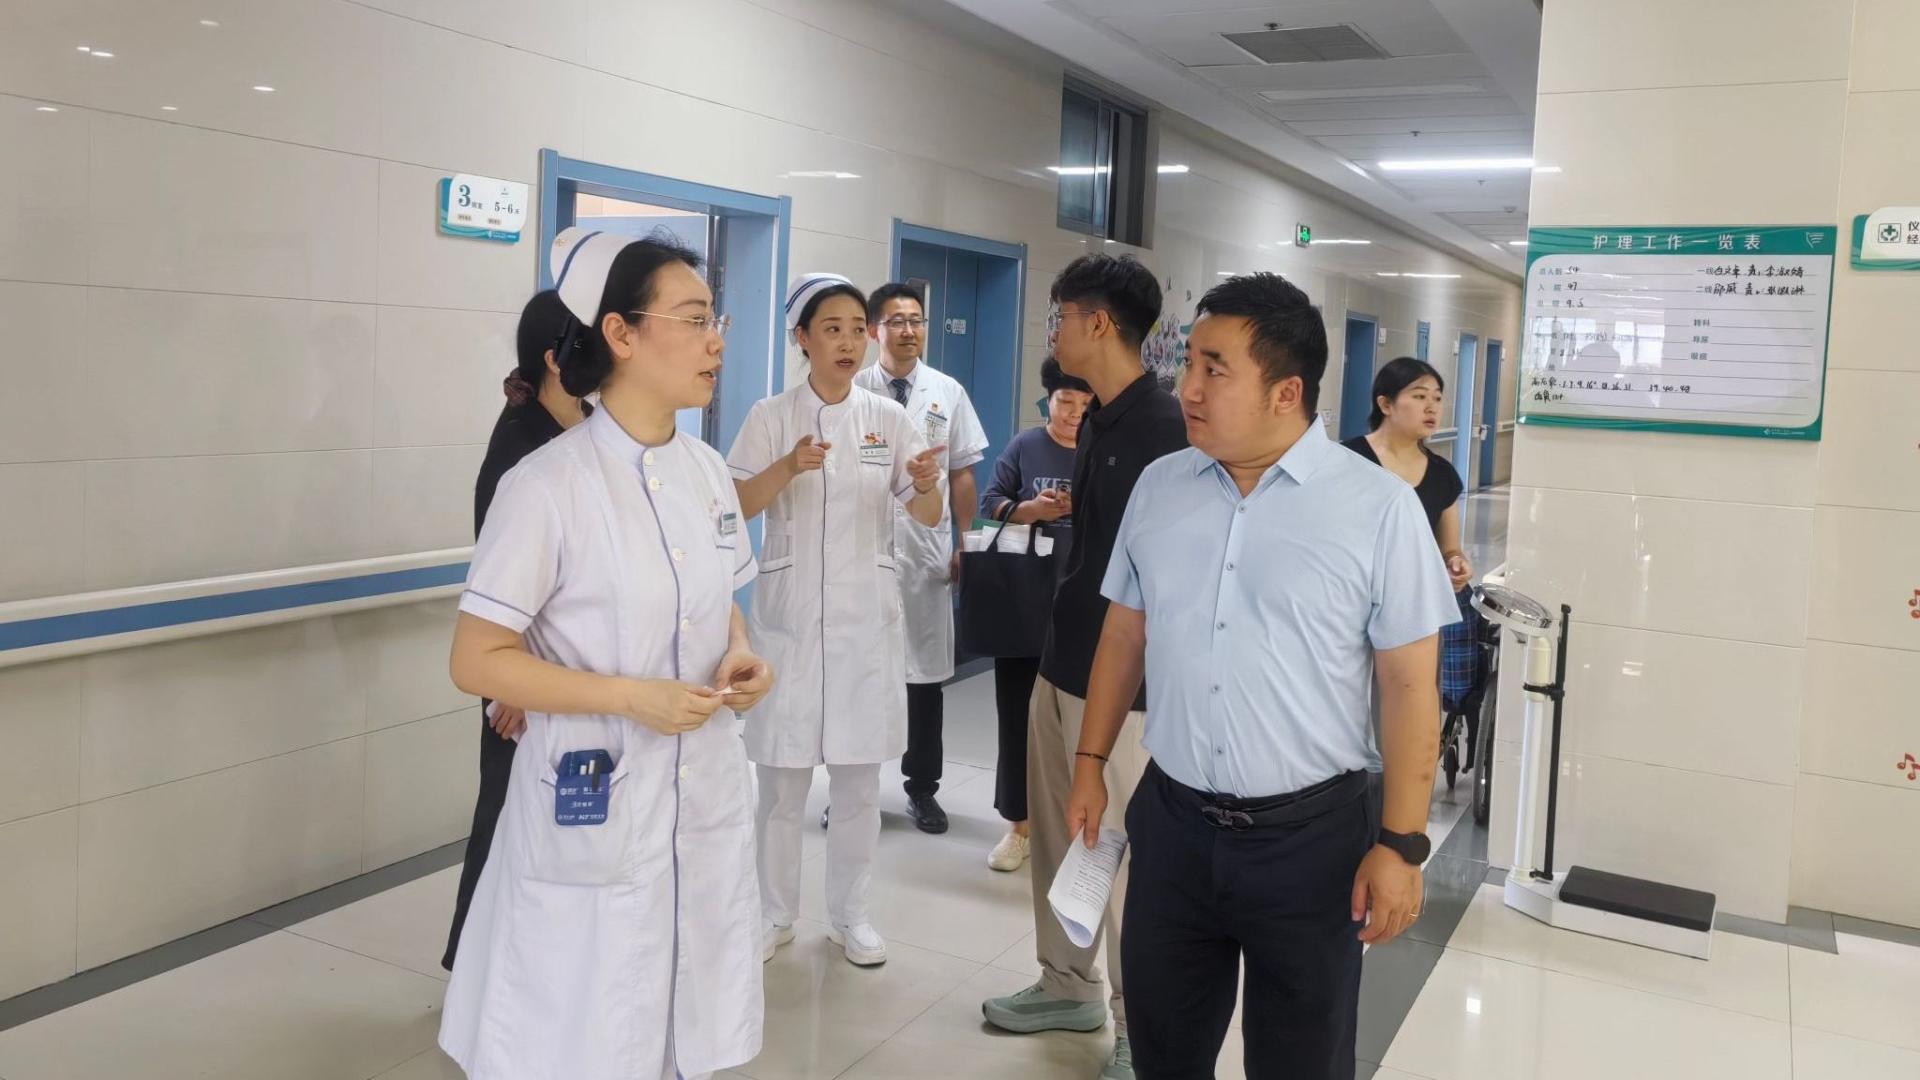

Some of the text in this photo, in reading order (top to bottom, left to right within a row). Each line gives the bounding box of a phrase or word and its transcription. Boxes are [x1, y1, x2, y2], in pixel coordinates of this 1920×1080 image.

[1908, 221, 1920, 231] 仪
[1592, 234, 1761, 251] 护理工作一览表
